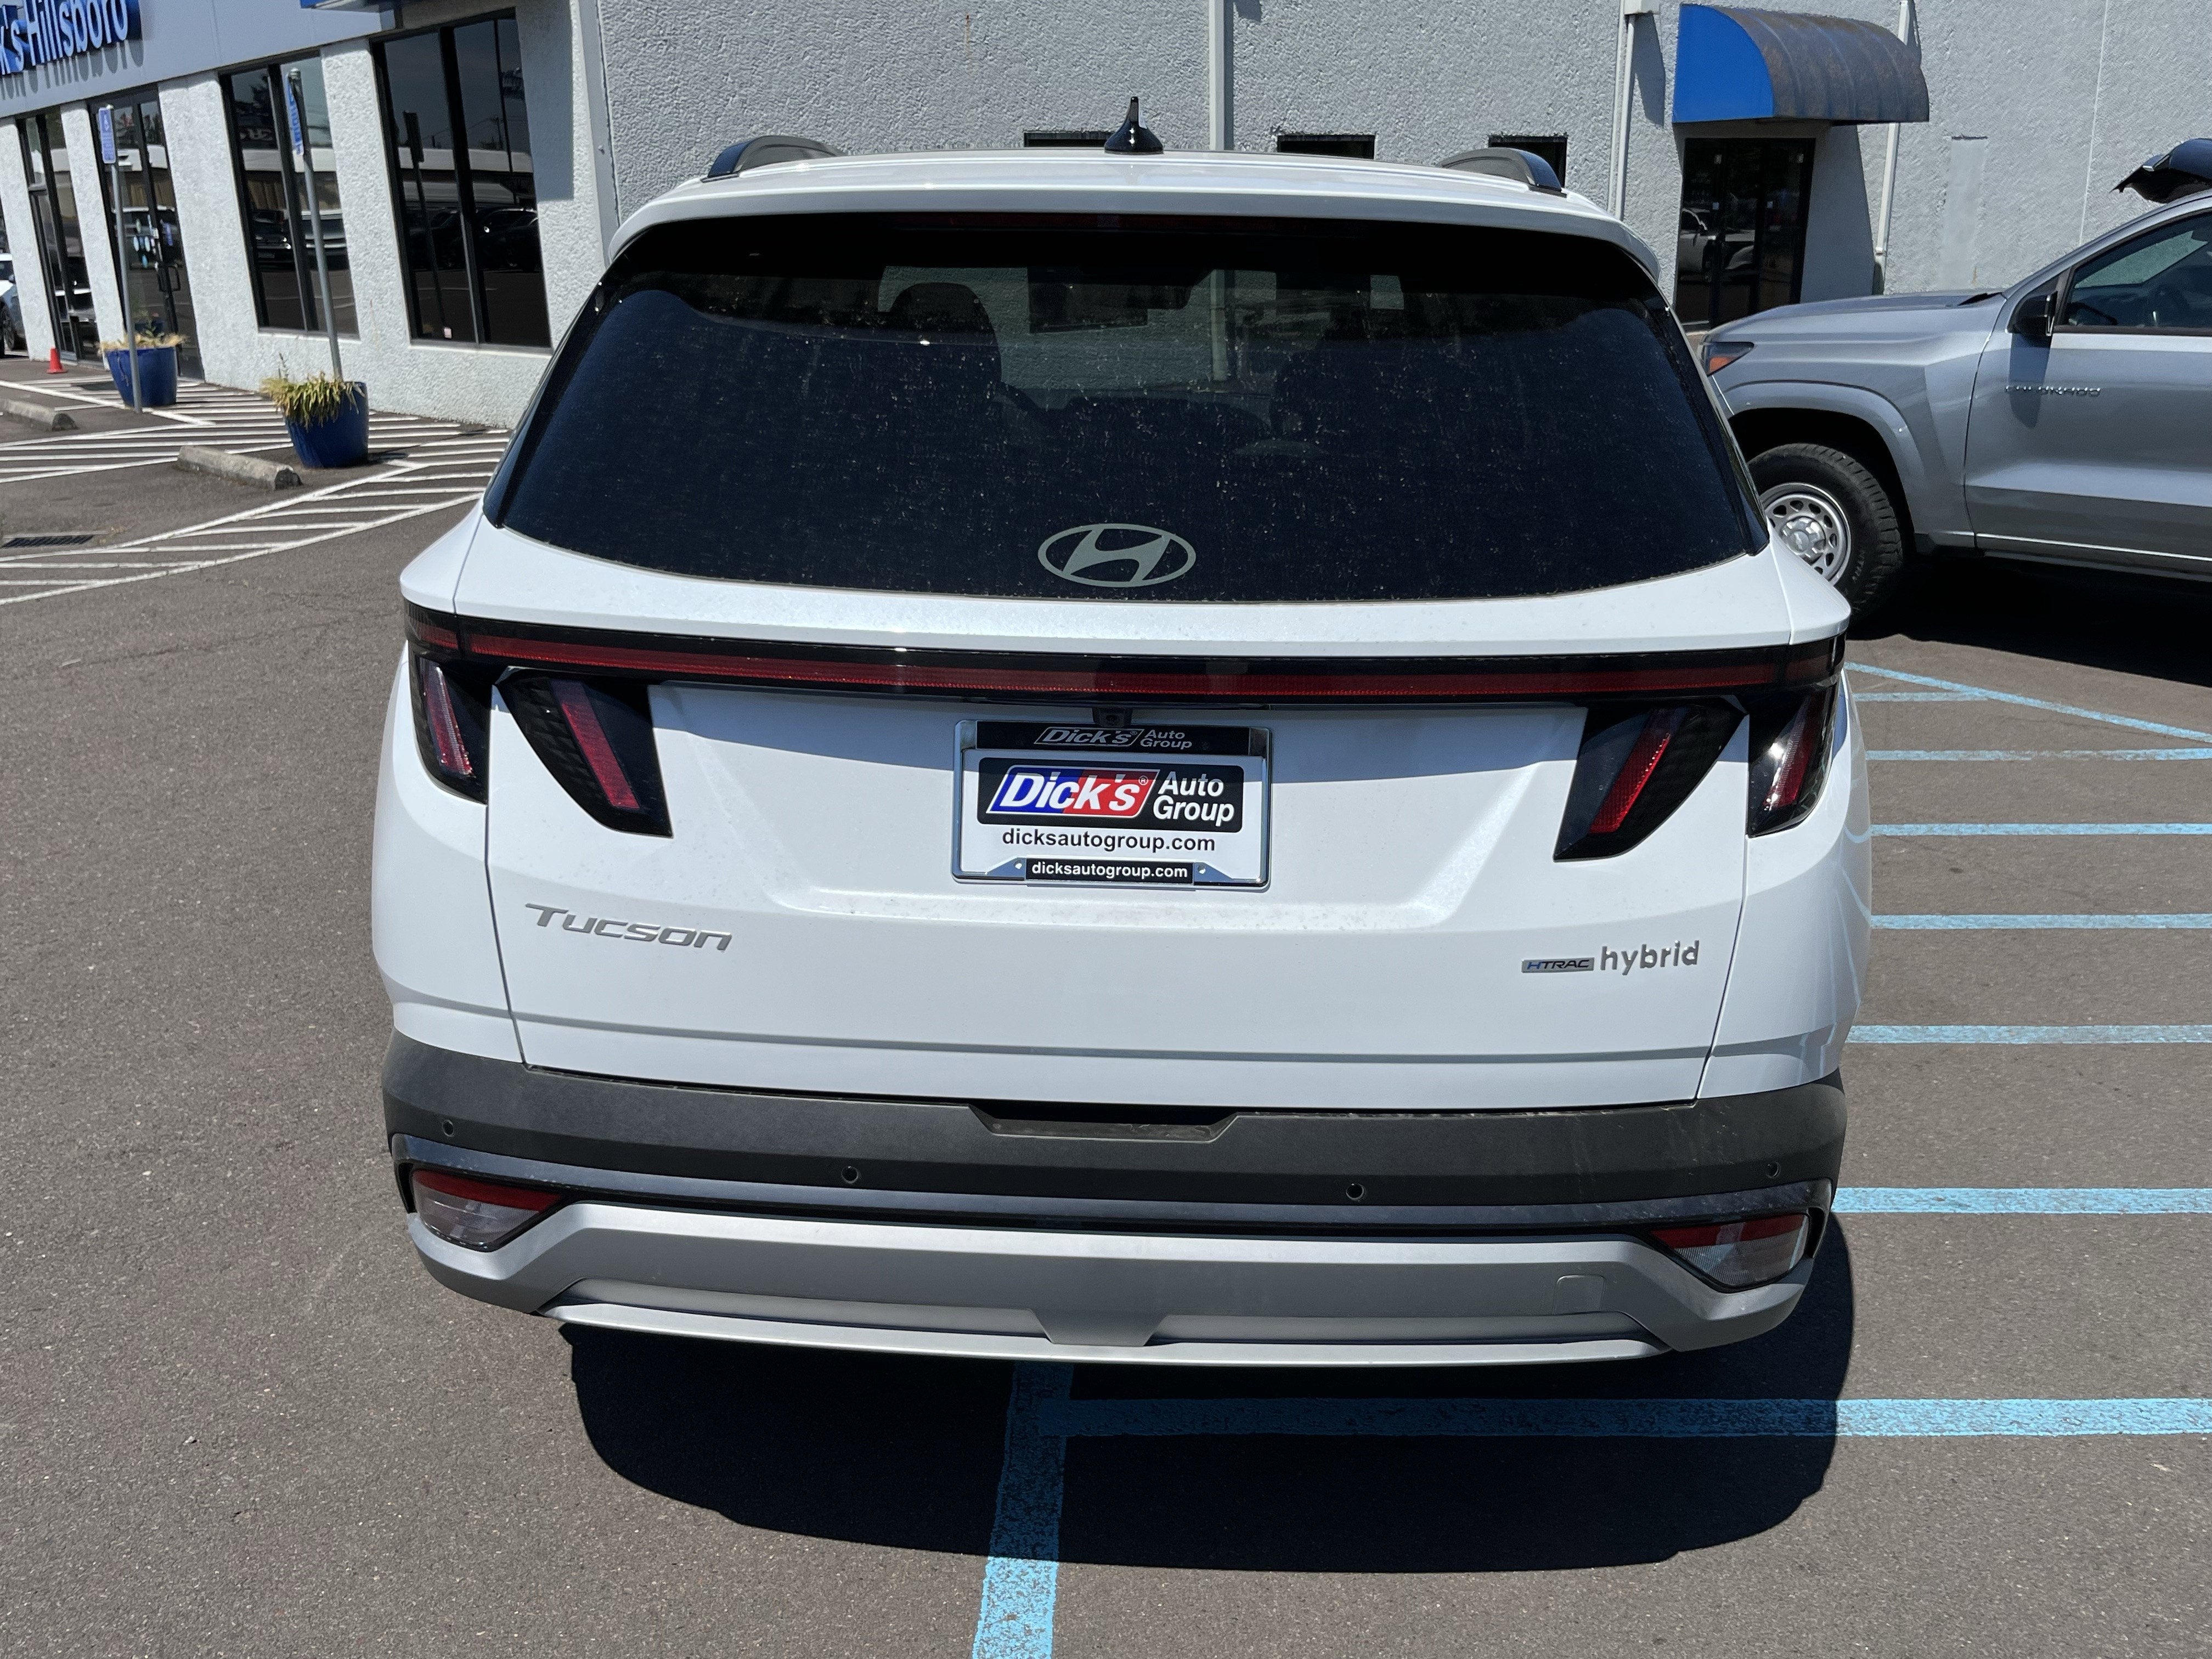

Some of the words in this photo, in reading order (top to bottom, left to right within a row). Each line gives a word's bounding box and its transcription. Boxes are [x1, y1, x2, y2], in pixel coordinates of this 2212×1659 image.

[24, 0, 128, 66] Hillsboro
[1140, 738, 1192, 749] Group
[1144, 729, 1185, 739] Auto
[1159, 771, 1224, 797] Auto
[1153, 796, 1234, 827] Group
[1002, 828, 1215, 853] dicksautogroup.com
[1031, 861, 1188, 879] dicksautogroup.com
[1526, 959, 1590, 969] HTRAC
[1600, 940, 1700, 975] hybrid
